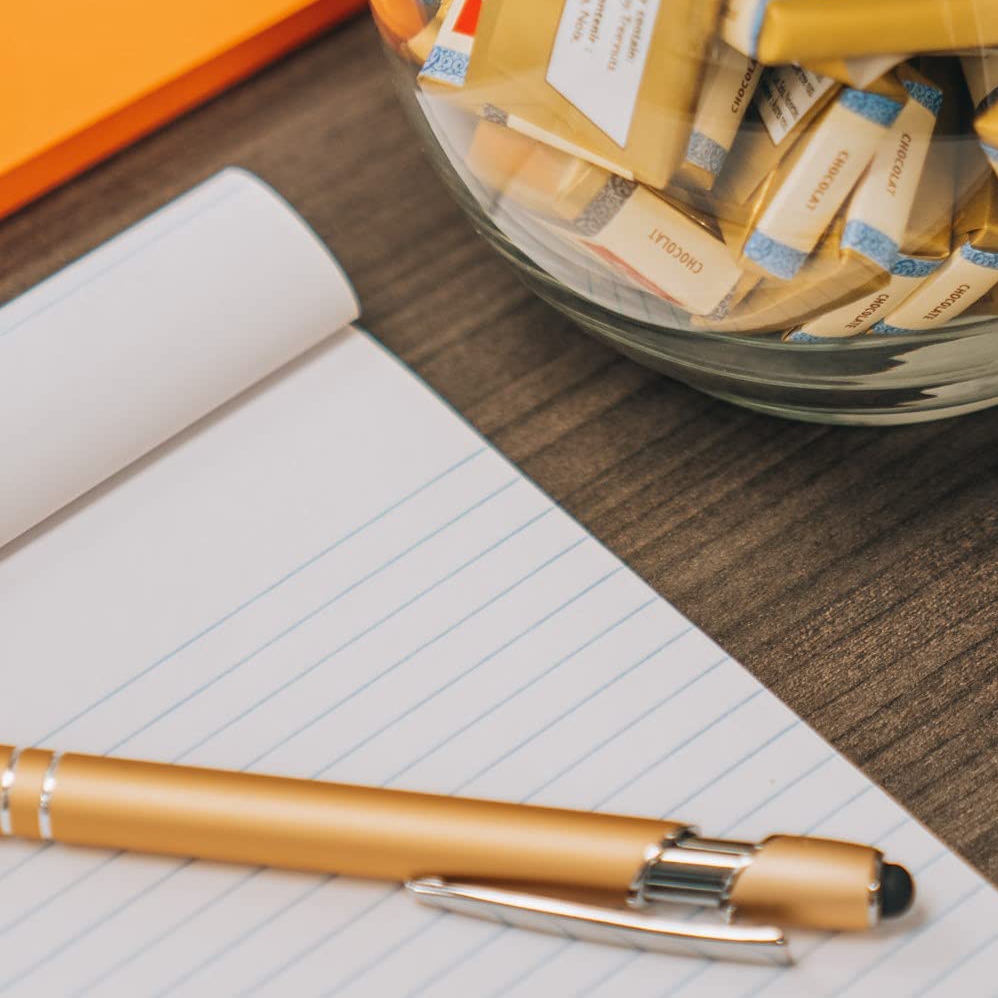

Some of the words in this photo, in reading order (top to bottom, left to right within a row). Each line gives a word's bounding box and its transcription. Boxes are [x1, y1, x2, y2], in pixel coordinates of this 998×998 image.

[805, 149, 849, 211] CHOCOLAT
[886, 133, 912, 196] CHOCOLAT
[648, 228, 704, 274] CHOCOLAT
[845, 293, 890, 329] CHOCOLATE
[923, 284, 970, 321] CHOCOLATE
